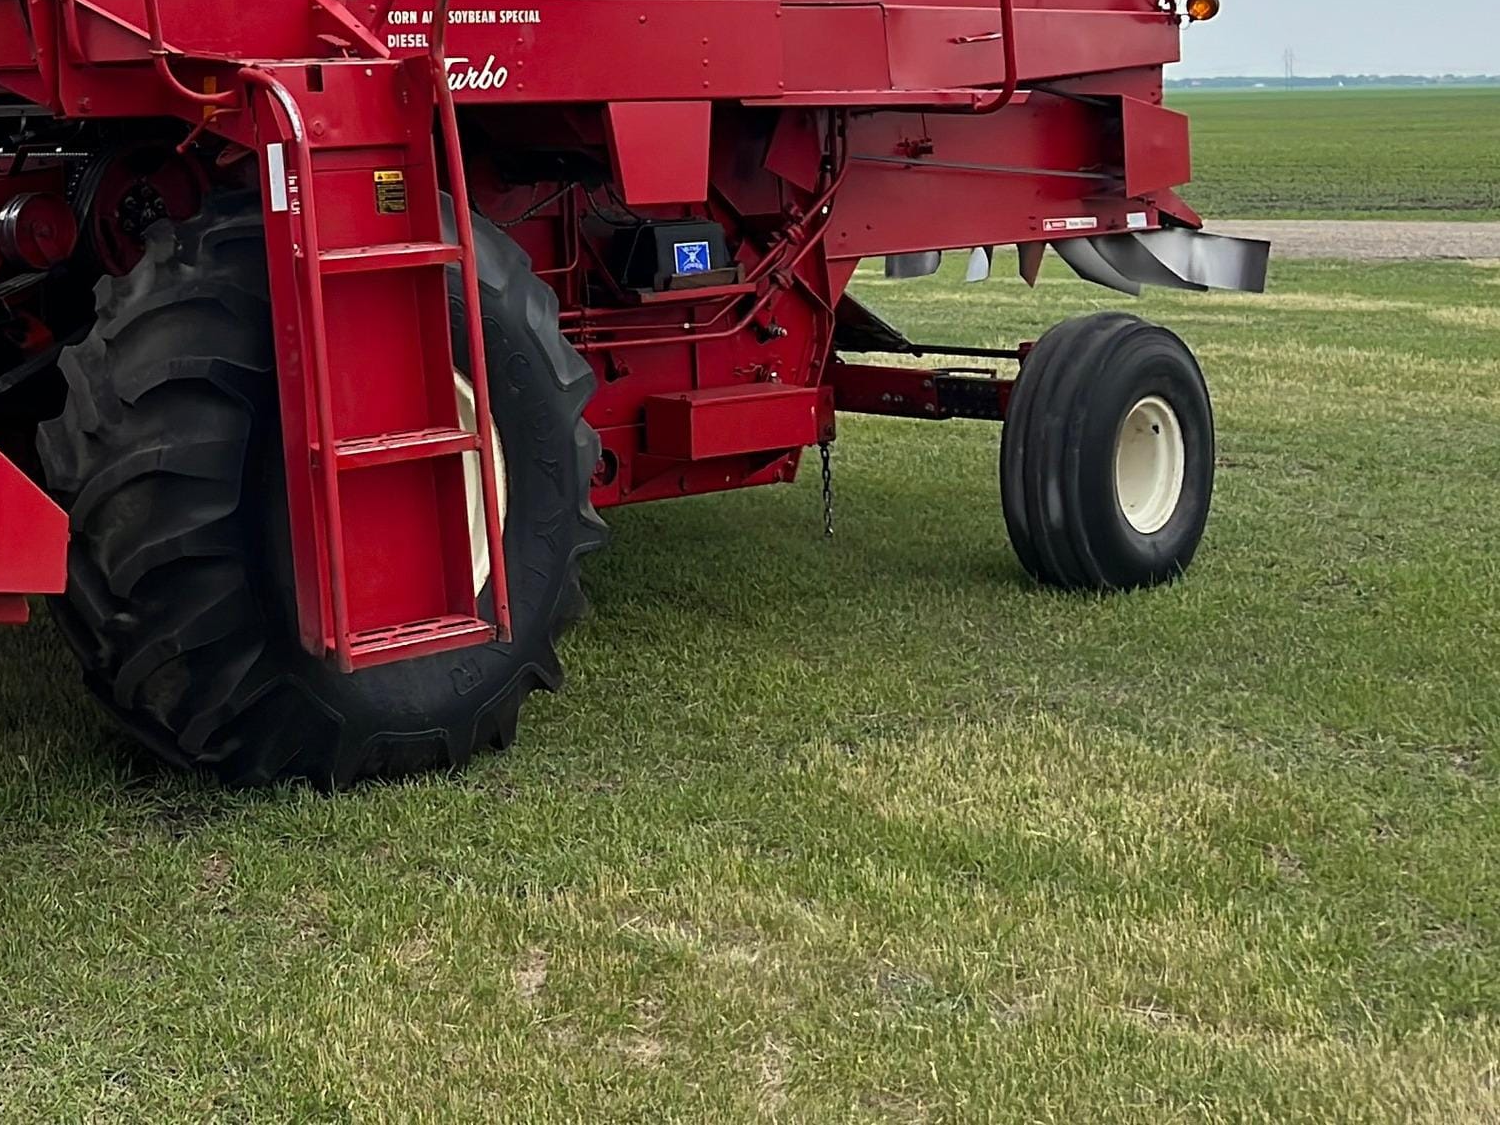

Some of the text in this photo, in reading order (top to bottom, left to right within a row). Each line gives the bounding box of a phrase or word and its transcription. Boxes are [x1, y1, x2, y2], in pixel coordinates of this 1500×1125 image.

[387, 10, 418, 25] CORN
[448, 10, 496, 24] SOYBEAN
[500, 9, 542, 24] SPECIAL
[387, 33, 429, 48] DIESEL
